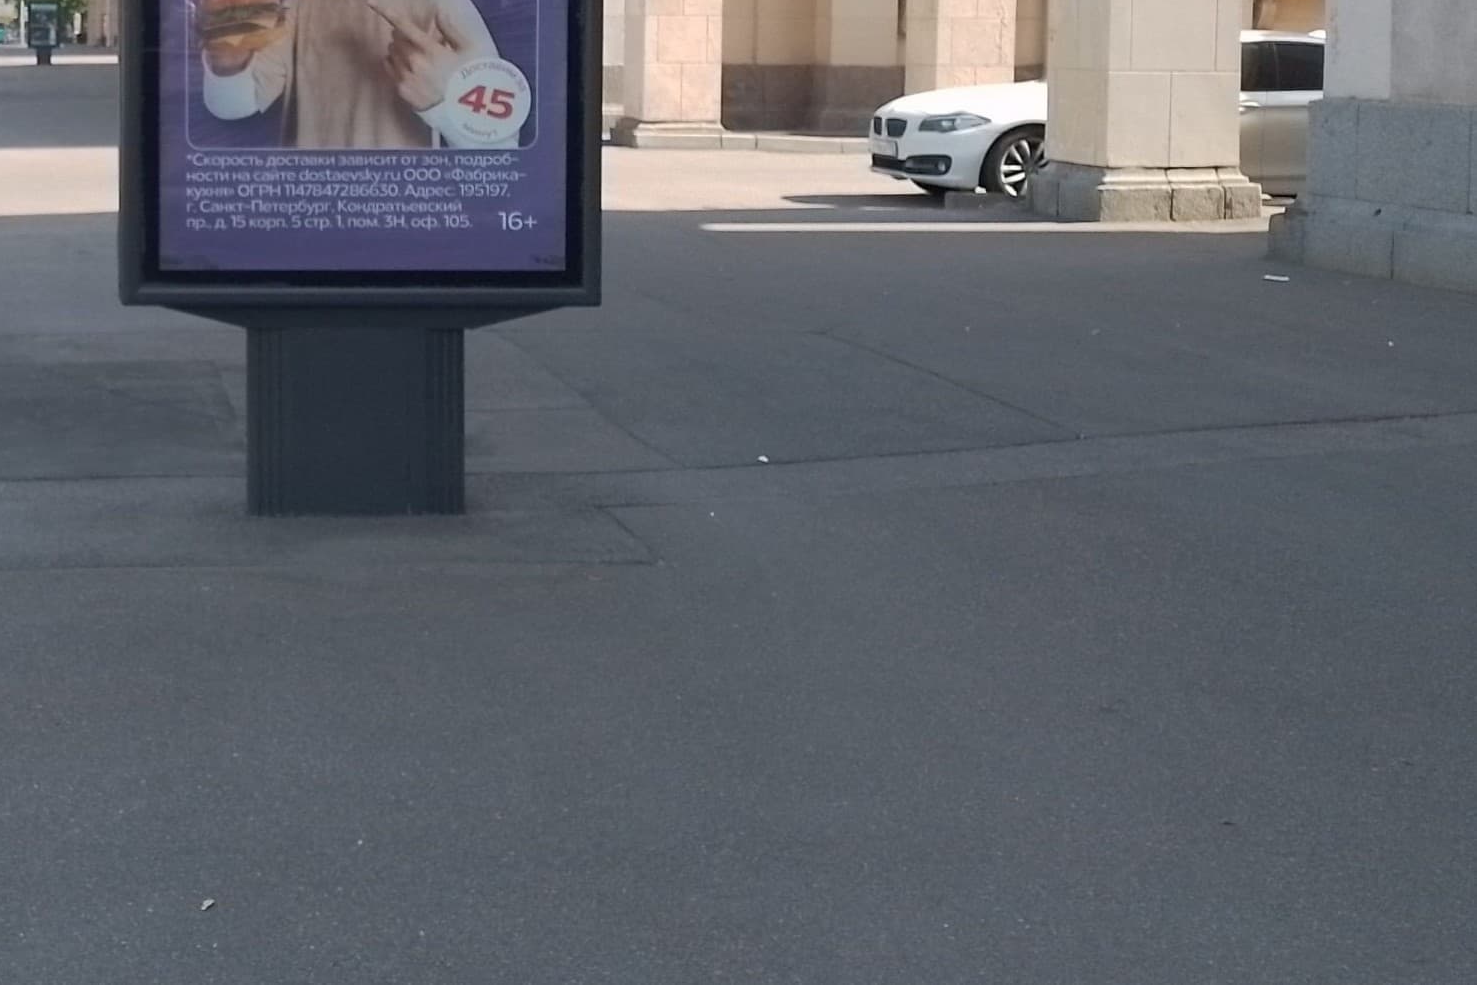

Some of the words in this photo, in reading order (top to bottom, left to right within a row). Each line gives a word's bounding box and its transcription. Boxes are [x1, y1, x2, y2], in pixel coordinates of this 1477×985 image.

[457, 84, 515, 119] 45
[266, 154, 335, 168] доставки
[336, 155, 398, 165] зависит
[401, 155, 418, 165] от
[186, 171, 229, 182] ности
[233, 171, 250, 182] на
[253, 168, 297, 182] сайте
[299, 168, 401, 184] dostaevsky.ru
[403, 168, 441, 182] ООО
[237, 184, 281, 197] ОГРН
[337, 199, 463, 216] Кондратьевский
[231, 216, 247, 229] 15
[291, 216, 302, 229] 5
[497, 211, 538, 231] 16+
